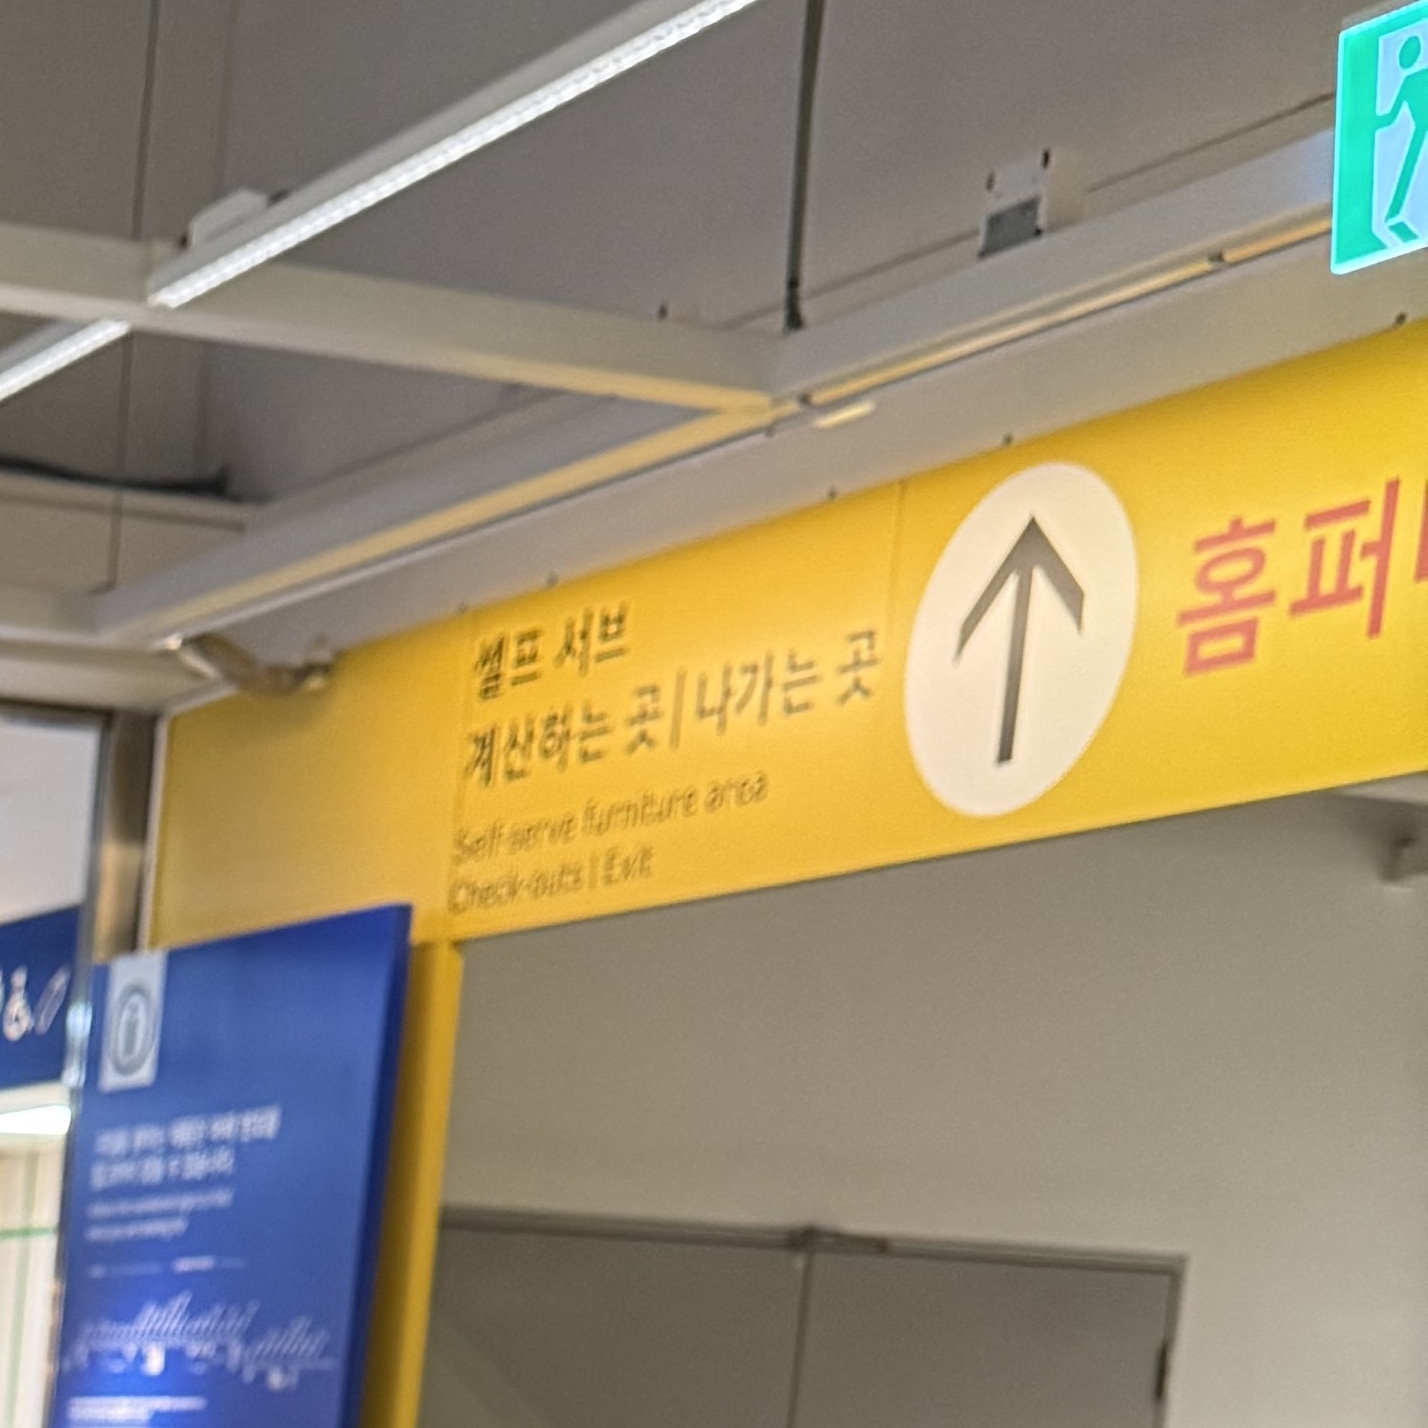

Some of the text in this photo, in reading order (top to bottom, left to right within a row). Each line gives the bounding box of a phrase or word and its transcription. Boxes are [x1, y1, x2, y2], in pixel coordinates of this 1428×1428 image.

[1174, 474, 1428, 677] 홈퍼
[554, 601, 629, 676] 서브
[465, 699, 612, 787] 계산하는
[625, 682, 664, 754] 곳
[696, 647, 823, 736] 나가는
[836, 627, 880, 706] 곳
[452, 769, 769, 865] Self-serve furniture area
[446, 862, 584, 915] Check-outs
[602, 845, 655, 888] Exit
